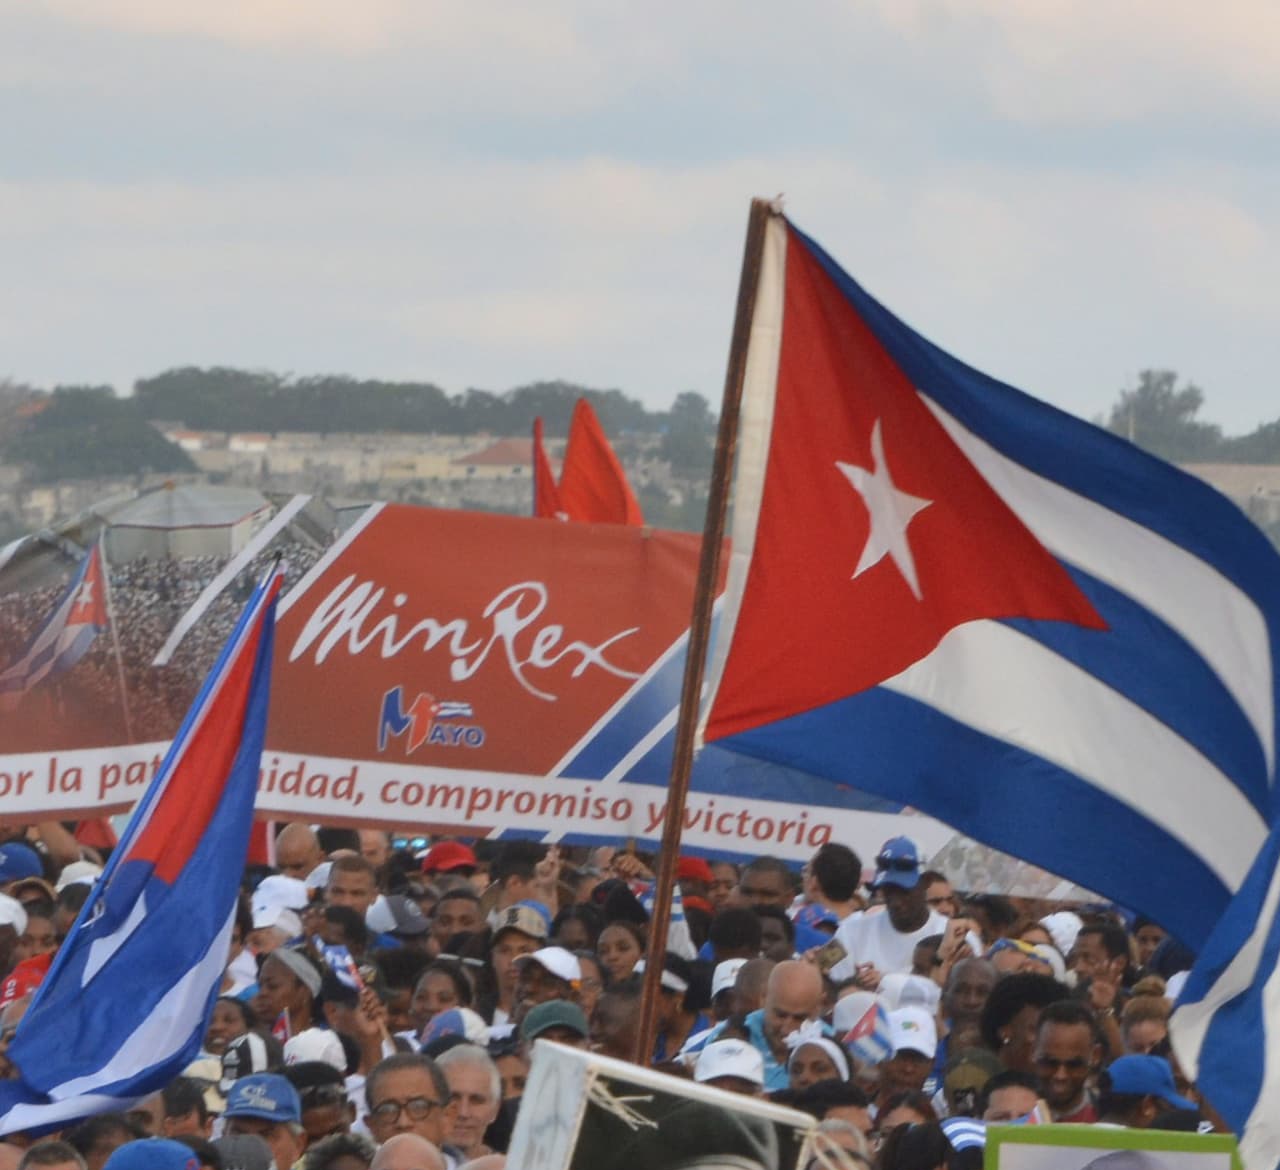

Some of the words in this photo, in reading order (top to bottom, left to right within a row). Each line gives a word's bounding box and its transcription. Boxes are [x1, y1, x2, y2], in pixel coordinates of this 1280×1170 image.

[288, 573, 643, 701] MinRex
[47, 757, 82, 794] la
[380, 777, 633, 822] compromiso
[644, 801, 667, 833] y
[682, 799, 834, 849] victoria
